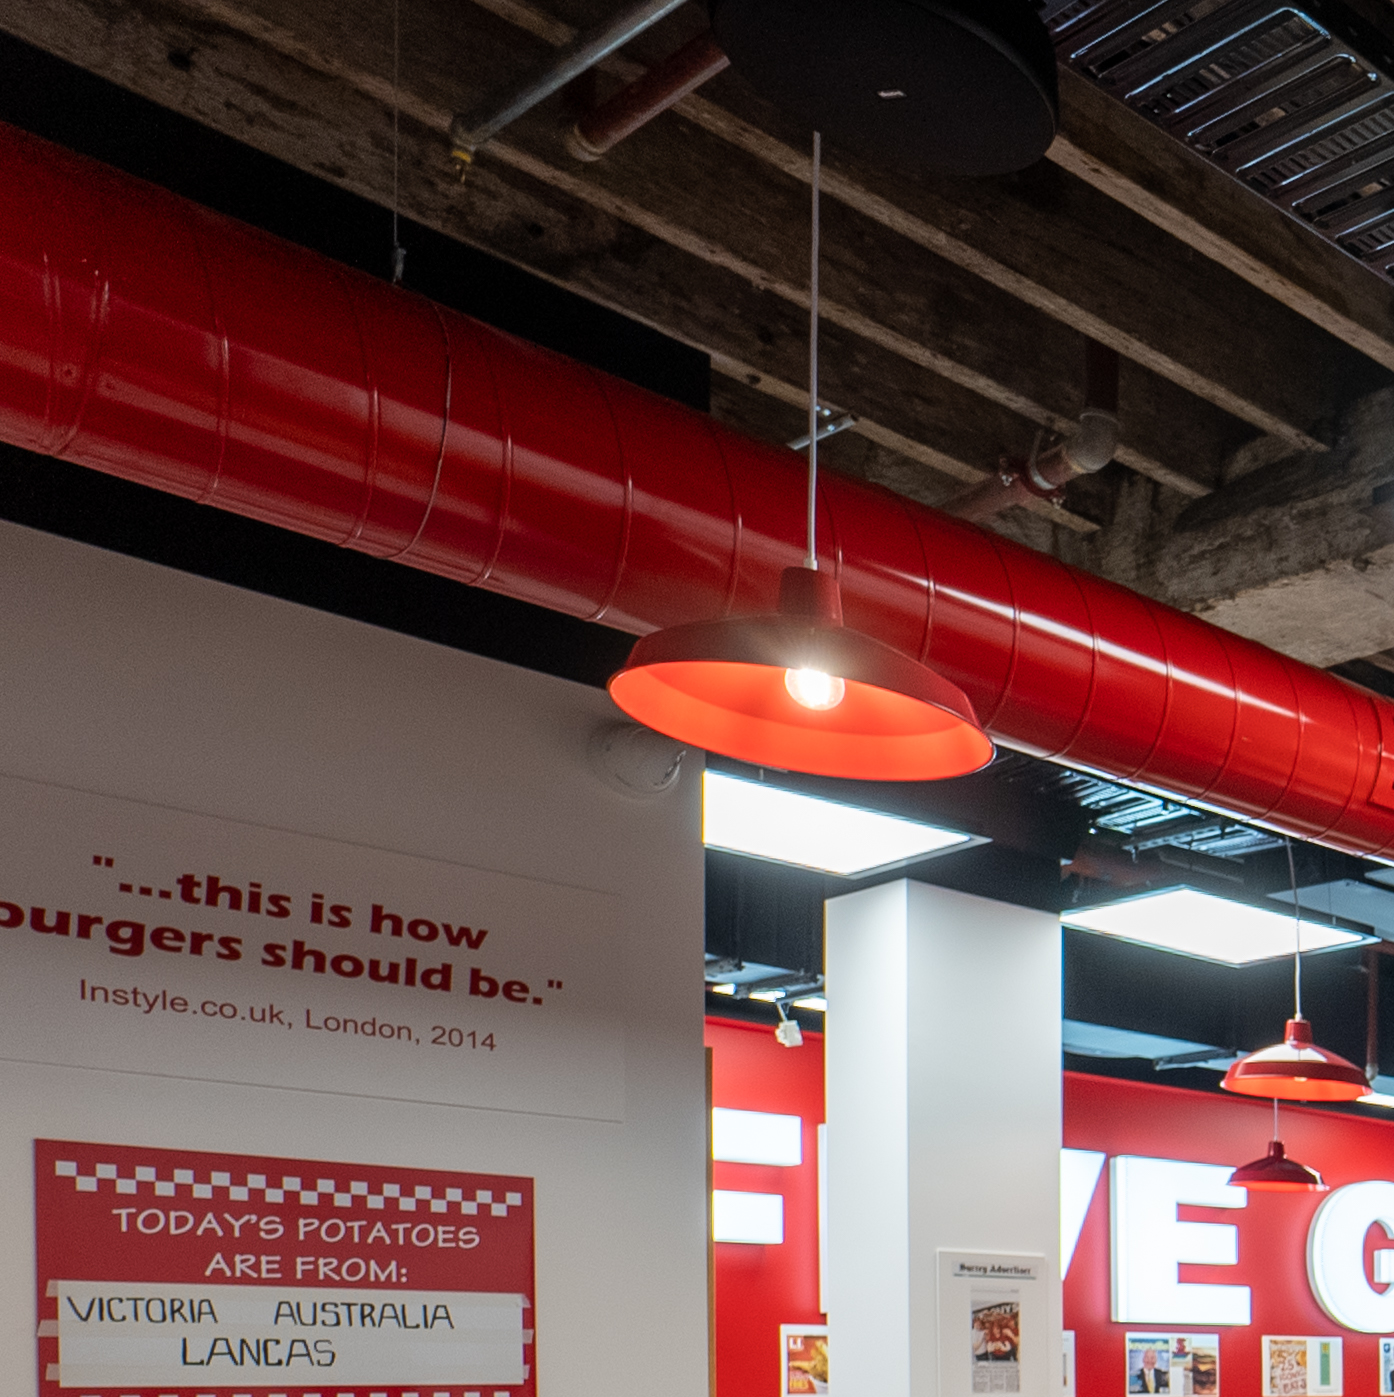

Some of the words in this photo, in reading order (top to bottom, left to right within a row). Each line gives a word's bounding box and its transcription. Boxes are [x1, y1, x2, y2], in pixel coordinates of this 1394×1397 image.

[310, 893, 352, 928] is
[370, 904, 488, 950] how
[261, 940, 452, 992] should
[469, 967, 563, 1005] be."
[80, 979, 293, 1029] Instyle.co.uk,
[305, 1008, 420, 1045] London,
[431, 1025, 497, 1051] 2014
[112, 1208, 285, 1240] TODAY'S
[299, 1218, 480, 1249] POTATOES
[205, 1253, 282, 1278] ARE
[296, 1256, 408, 1283] FROM:
[67, 1296, 218, 1324] VICTORIA
[274, 1300, 454, 1329] AUSTRALIA
[182, 1337, 336, 1367] LANCAS
